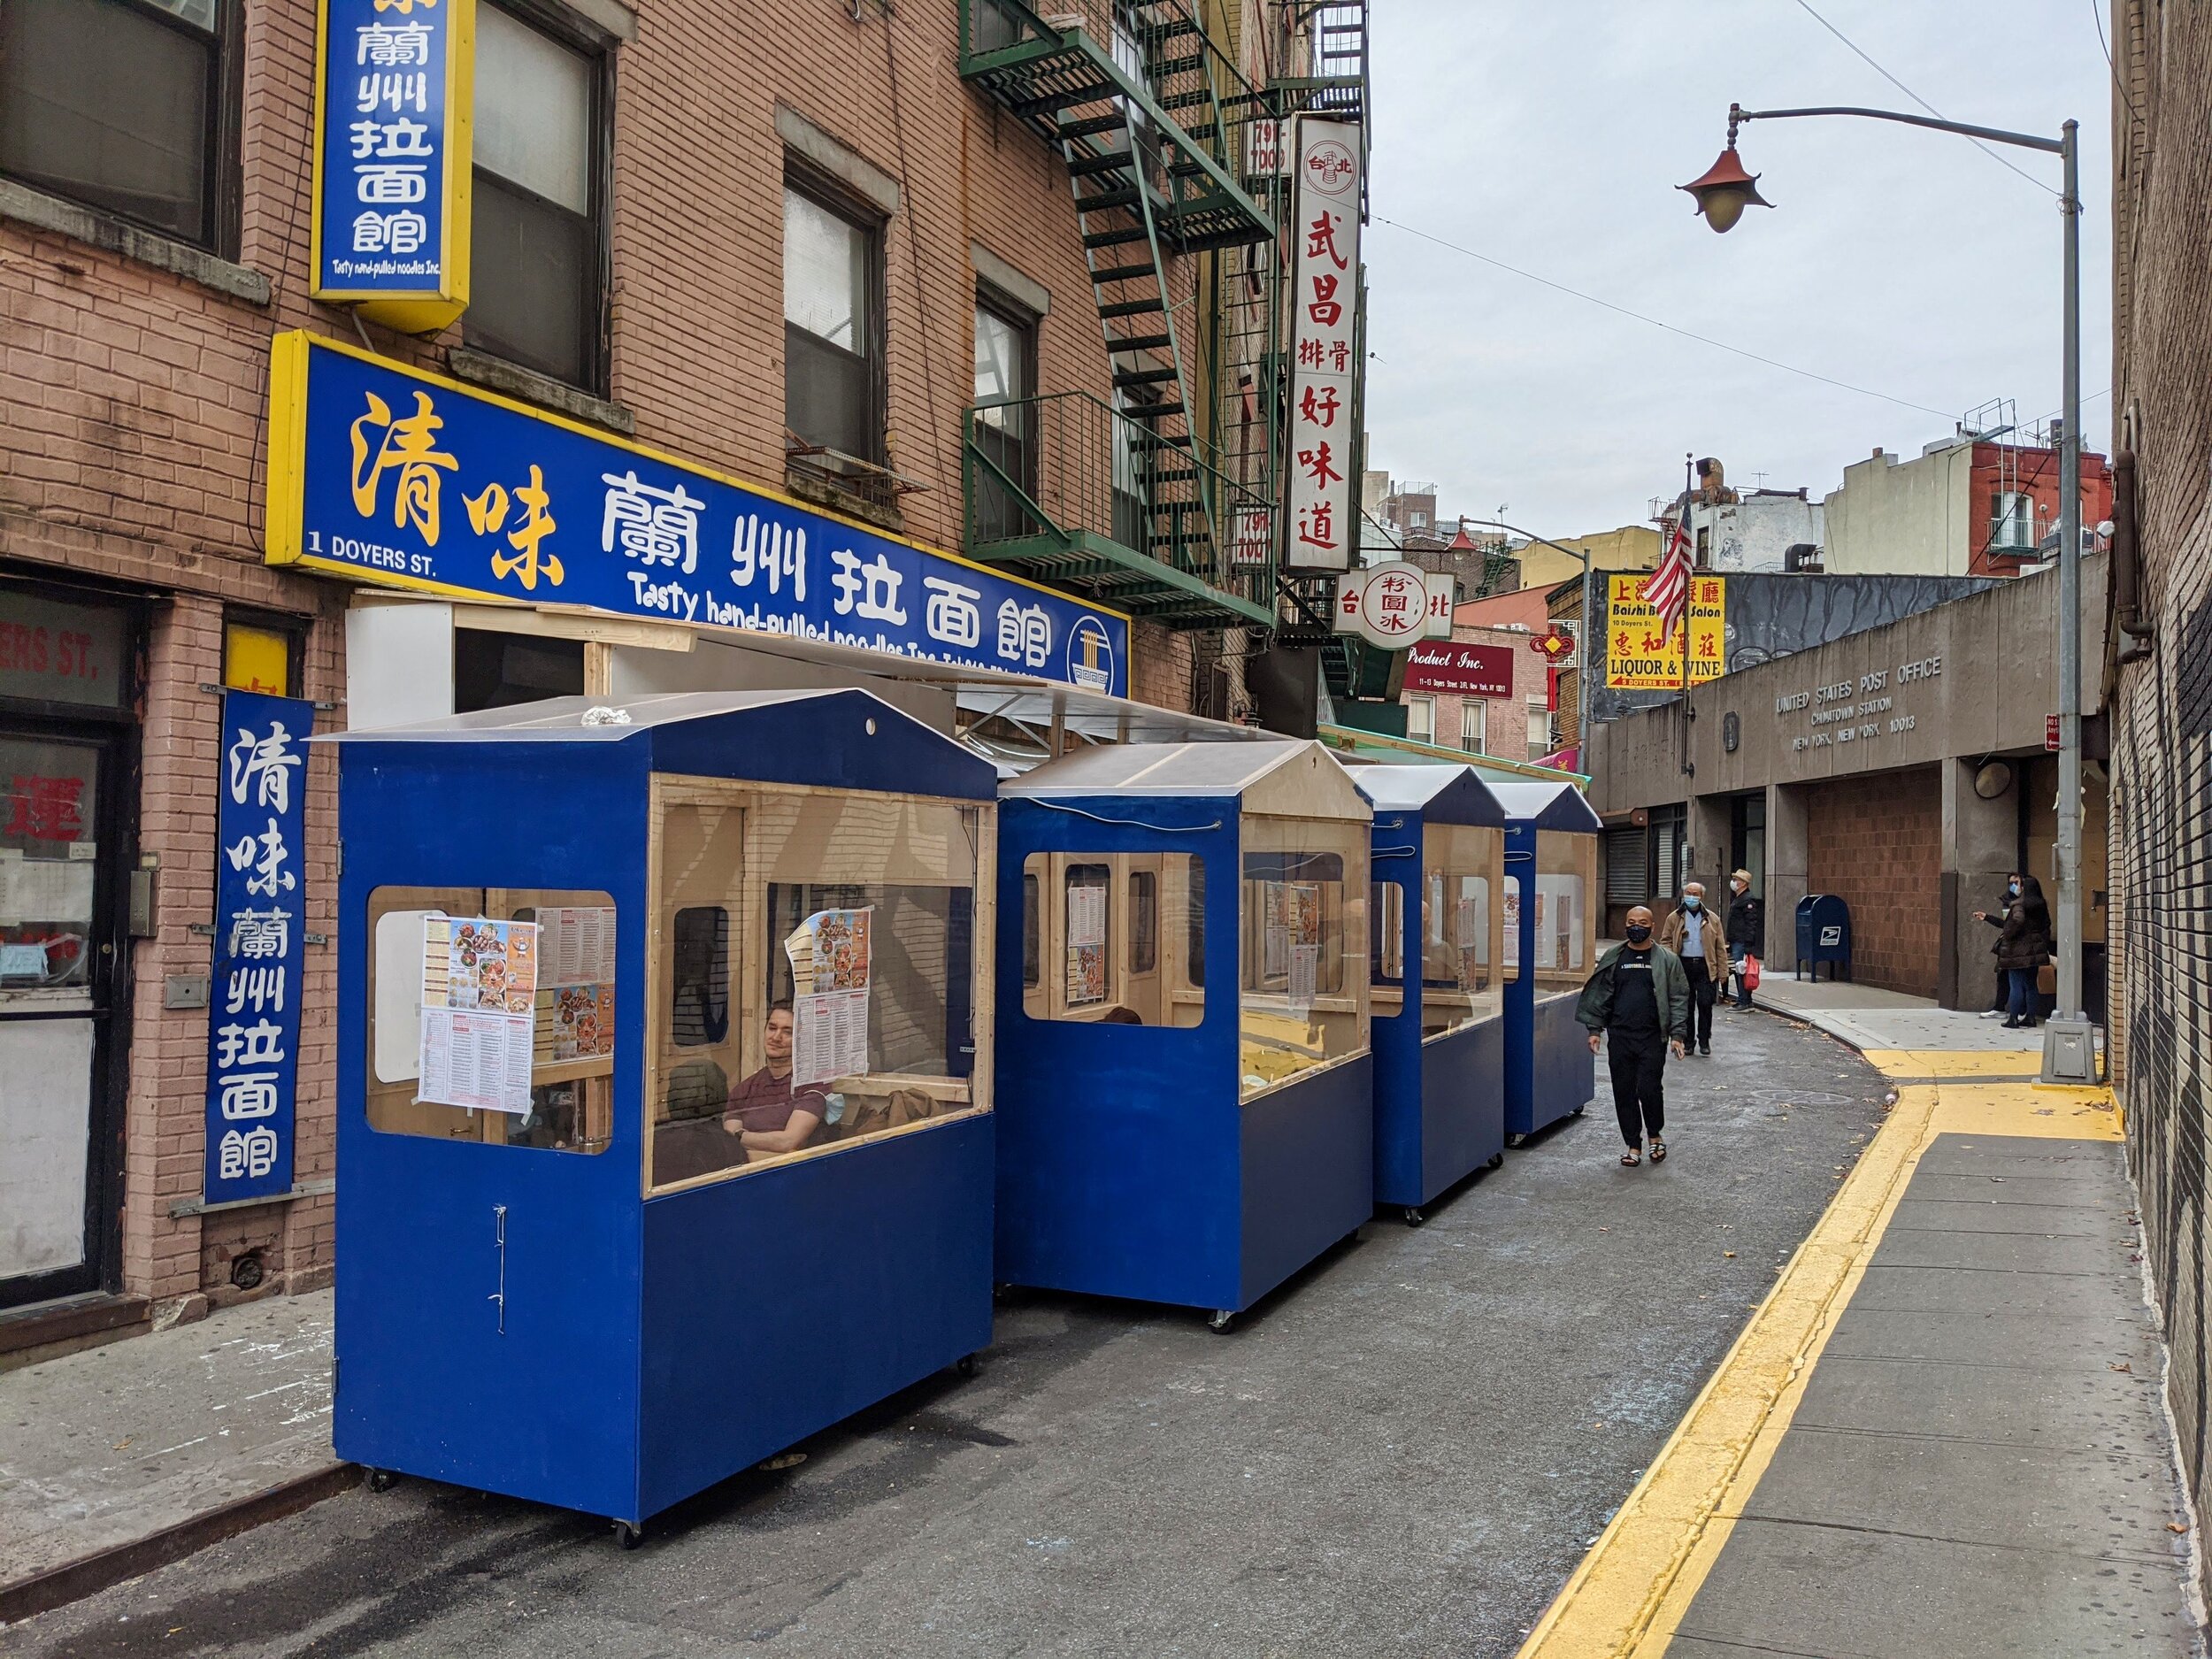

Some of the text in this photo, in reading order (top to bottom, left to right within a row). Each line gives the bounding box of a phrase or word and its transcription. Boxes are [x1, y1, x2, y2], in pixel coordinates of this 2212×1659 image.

[349, 0, 435, 254] 蘭州拉面館
[332, 259, 353, 278] Tasty
[397, 260, 424, 274] noodles
[426, 258, 441, 274] Inc.
[1298, 339, 1351, 373] 排骨
[1296, 386, 1344, 550] 好味道
[308, 531, 436, 577] 1 DOYERS ST.
[626, 572, 699, 621] Tasty
[1340, 589, 1360, 614] 台
[1430, 593, 1449, 618] 北
[1612, 604, 1647, 616] Baishi
[1690, 605, 1721, 618] Salon
[1407, 647, 1484, 670] Product Inc.
[1610, 659, 1721, 678] LIQUOR & WINE
[1776, 656, 1942, 715] UNITED STATES POST OFFICE
[1810, 696, 1892, 726] CHINATOWN STATION
[1793, 736, 1810, 752] NEW
[1837, 727, 1856, 744] NEW
[1859, 722, 1881, 739] YORK
[1889, 714, 1916, 733] 10013
[217, 721, 302, 1179] 清味蘭州拉面館
